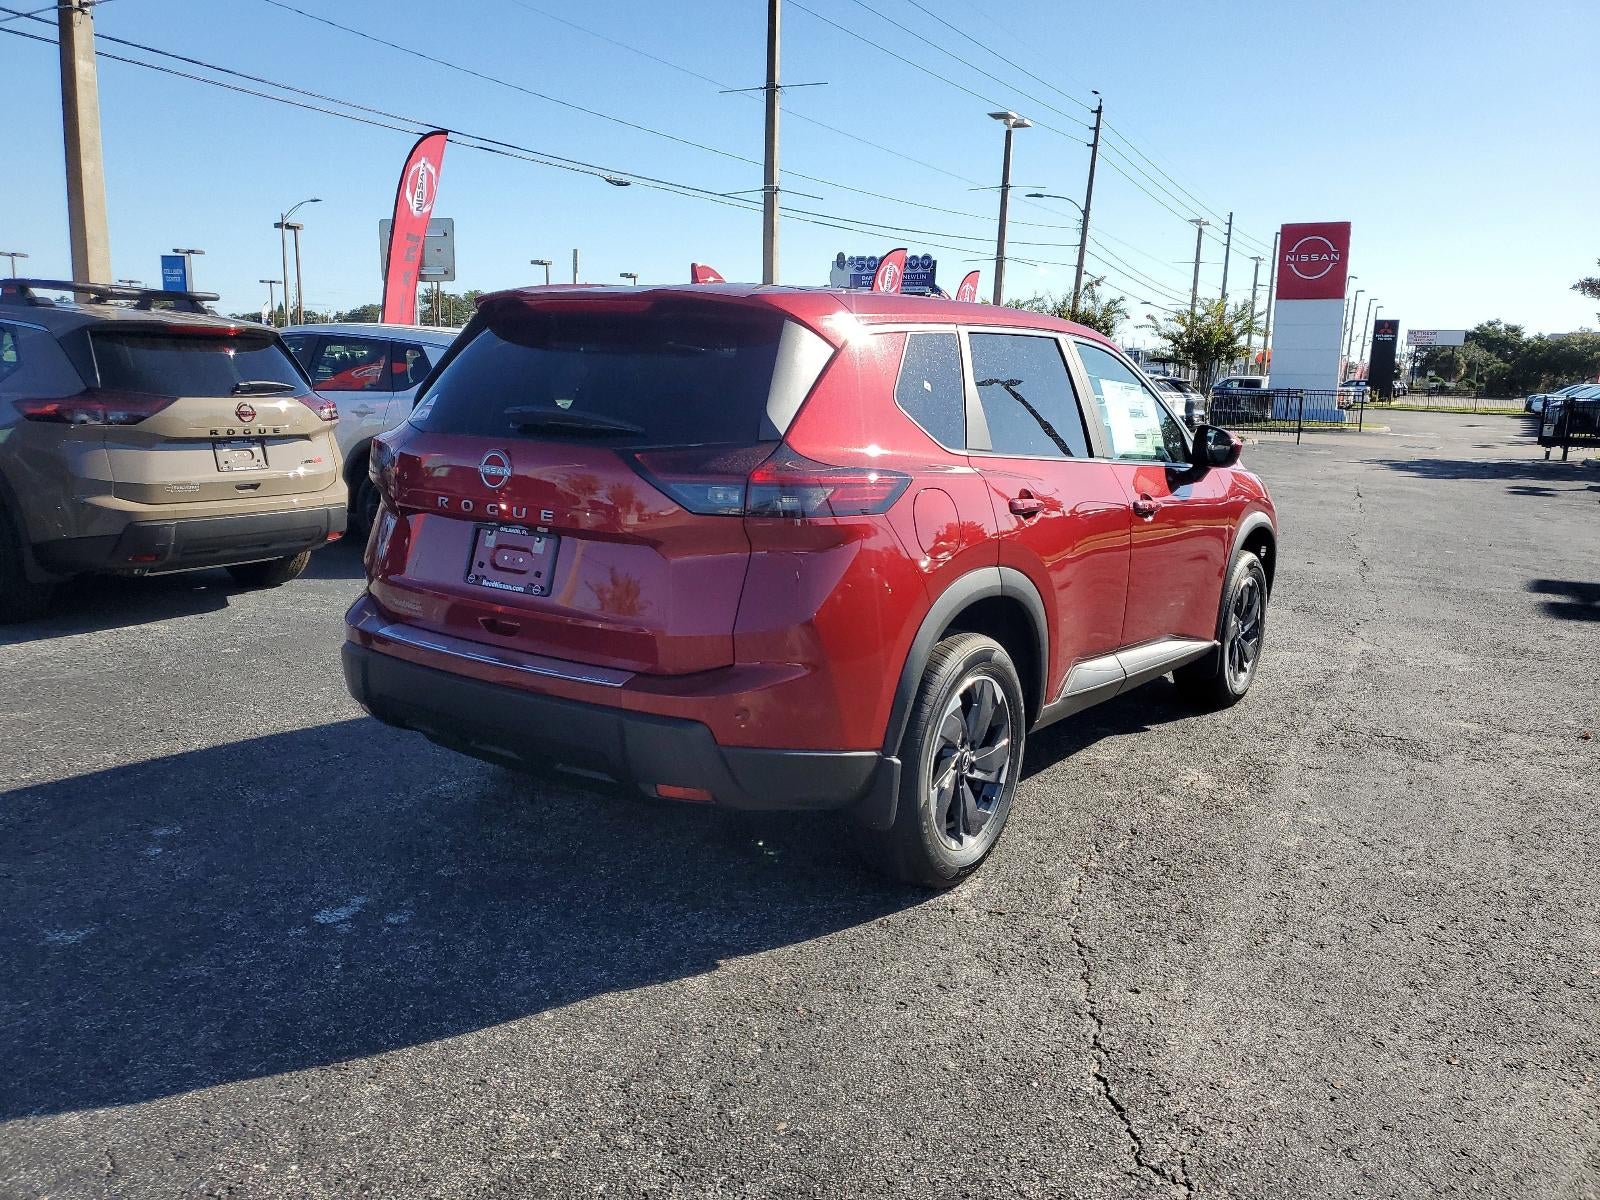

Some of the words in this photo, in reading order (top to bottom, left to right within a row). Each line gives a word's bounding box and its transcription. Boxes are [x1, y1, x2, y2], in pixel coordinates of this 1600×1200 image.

[415, 162, 427, 213] NISSAN
[1285, 253, 1340, 262] NISSAN
[209, 428, 281, 436] ROGUE
[478, 465, 512, 476] NISSAN
[437, 496, 554, 522] ROGUE
